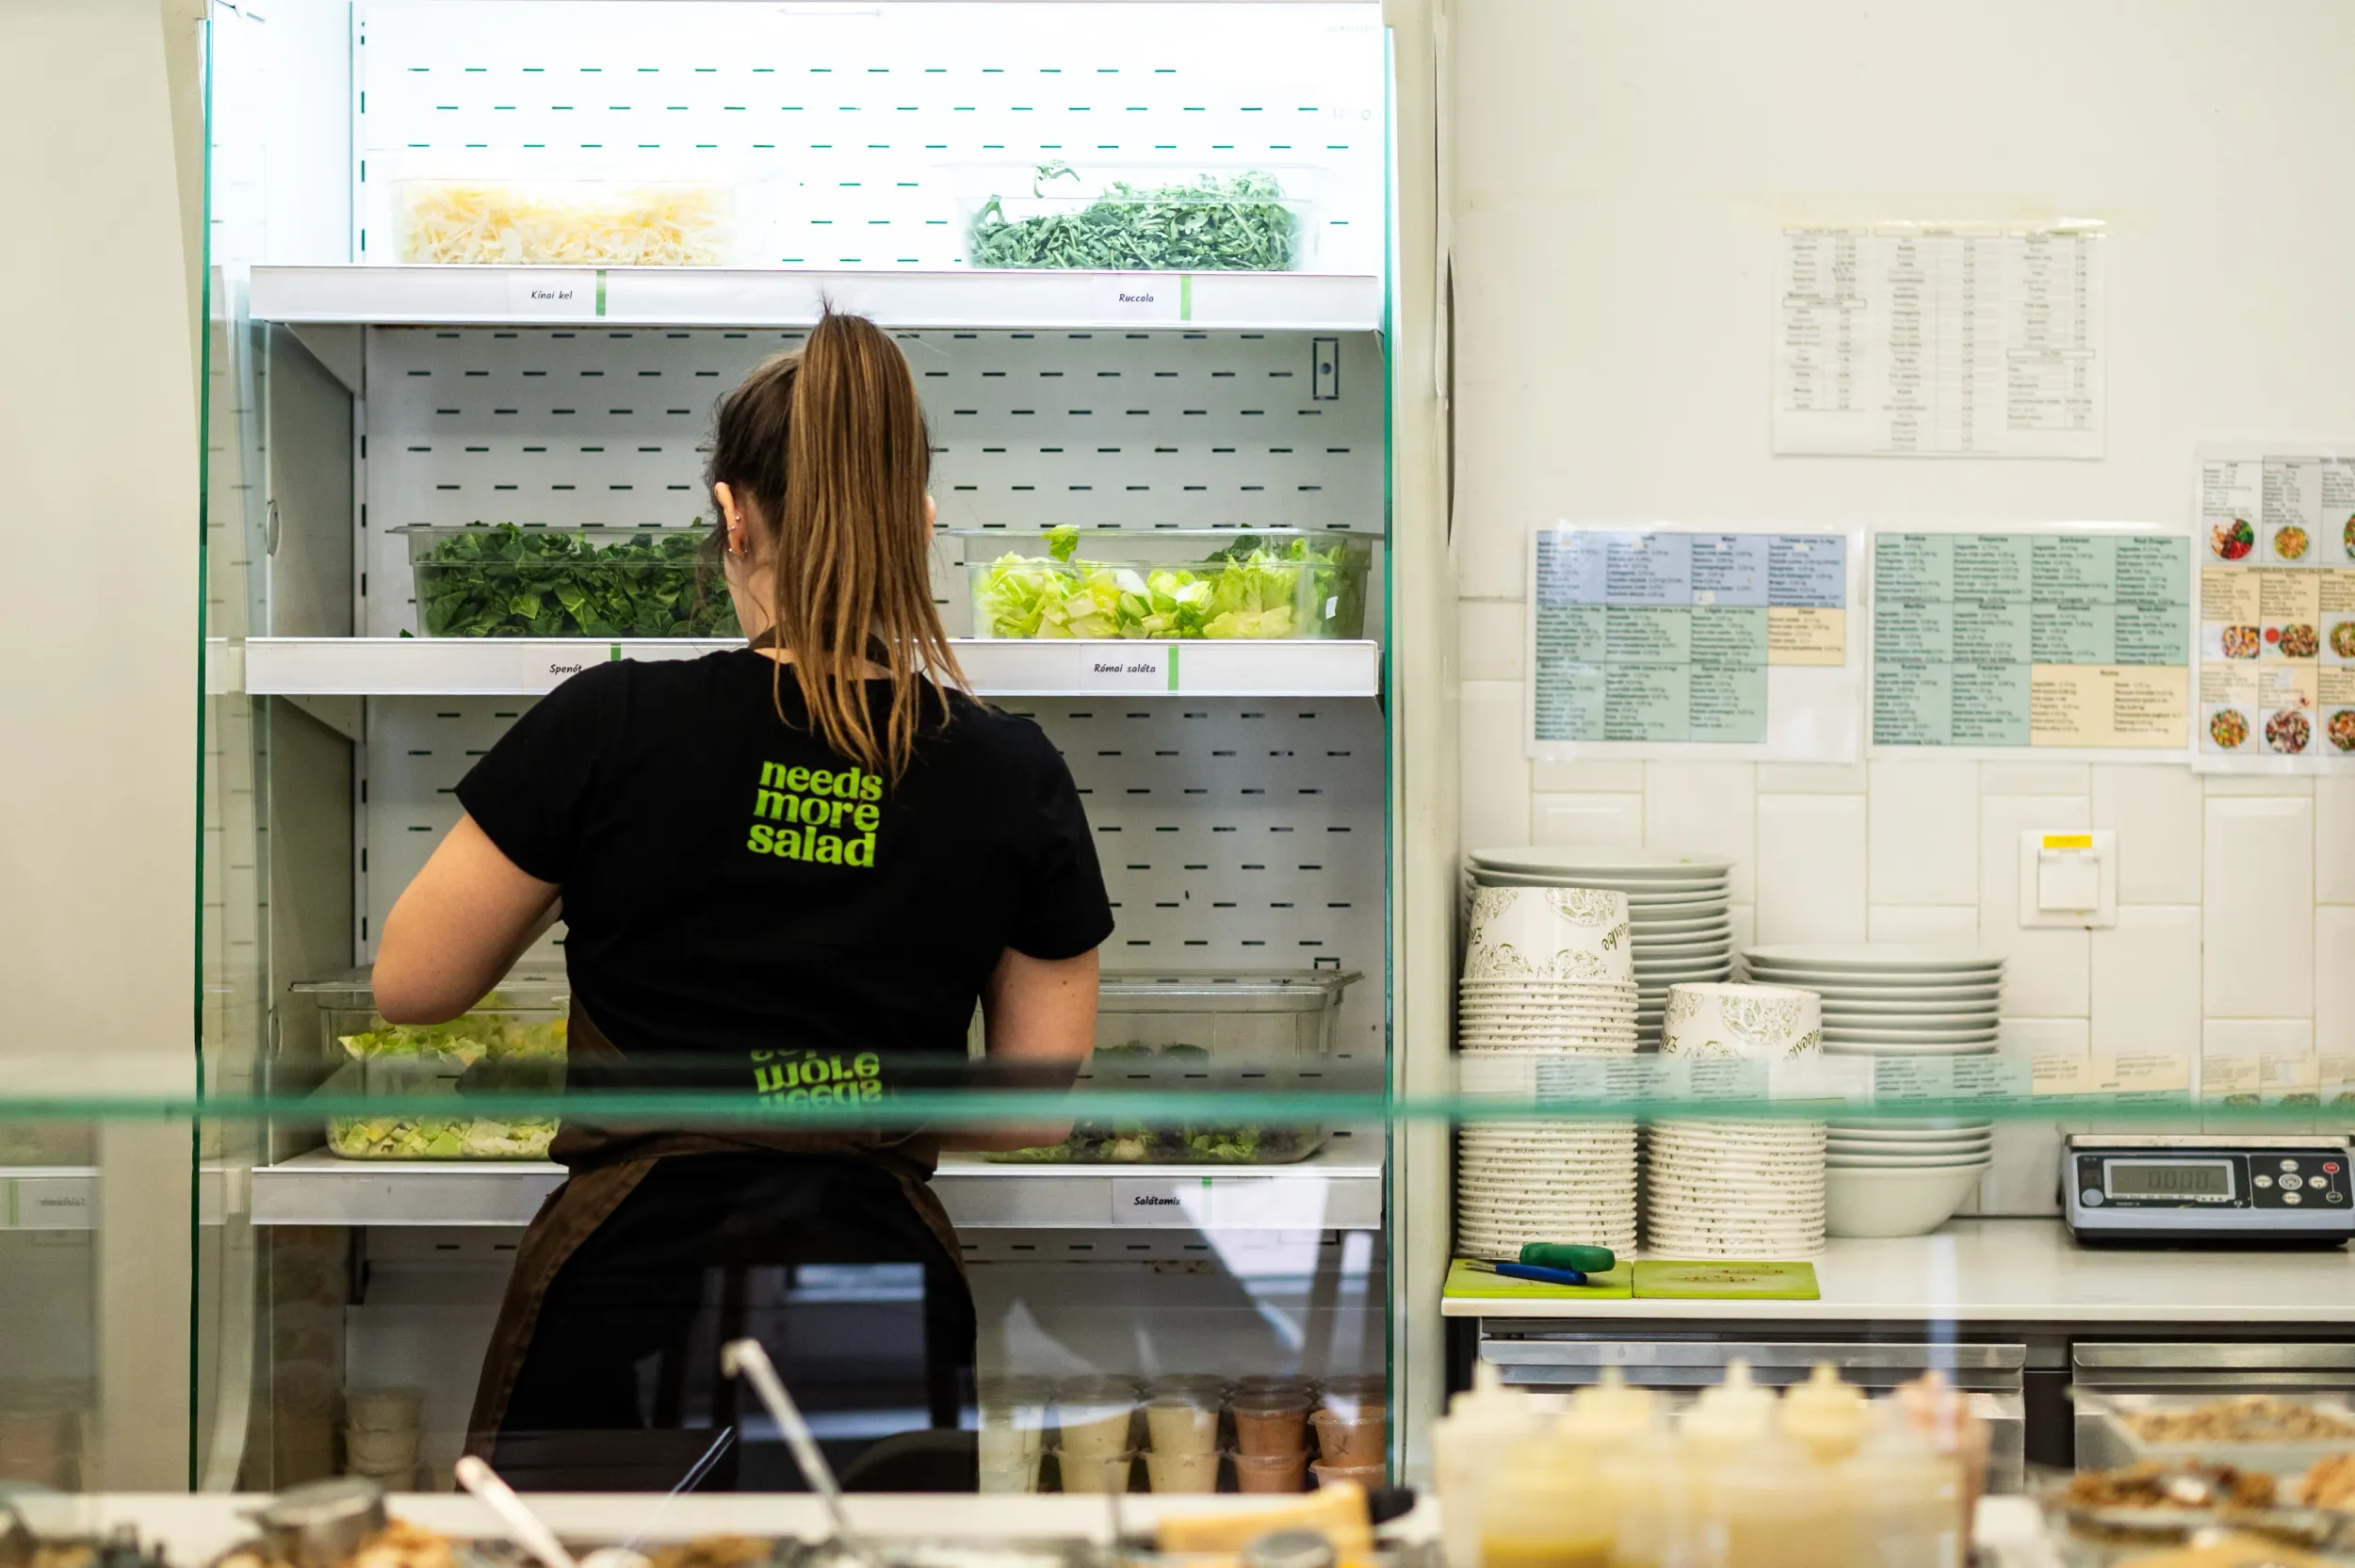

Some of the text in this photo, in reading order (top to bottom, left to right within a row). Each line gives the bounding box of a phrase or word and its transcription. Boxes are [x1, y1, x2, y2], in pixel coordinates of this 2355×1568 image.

[531, 290, 573, 299] Kínai kel
[1119, 293, 1154, 302] Ruccola
[549, 664, 582, 675] Spenót
[1094, 664, 1156, 672] Római saláta
[759, 760, 883, 801] needs
[754, 788, 880, 832] more
[747, 824, 876, 867] salad
[1133, 1195, 1181, 1205] Salátamix
